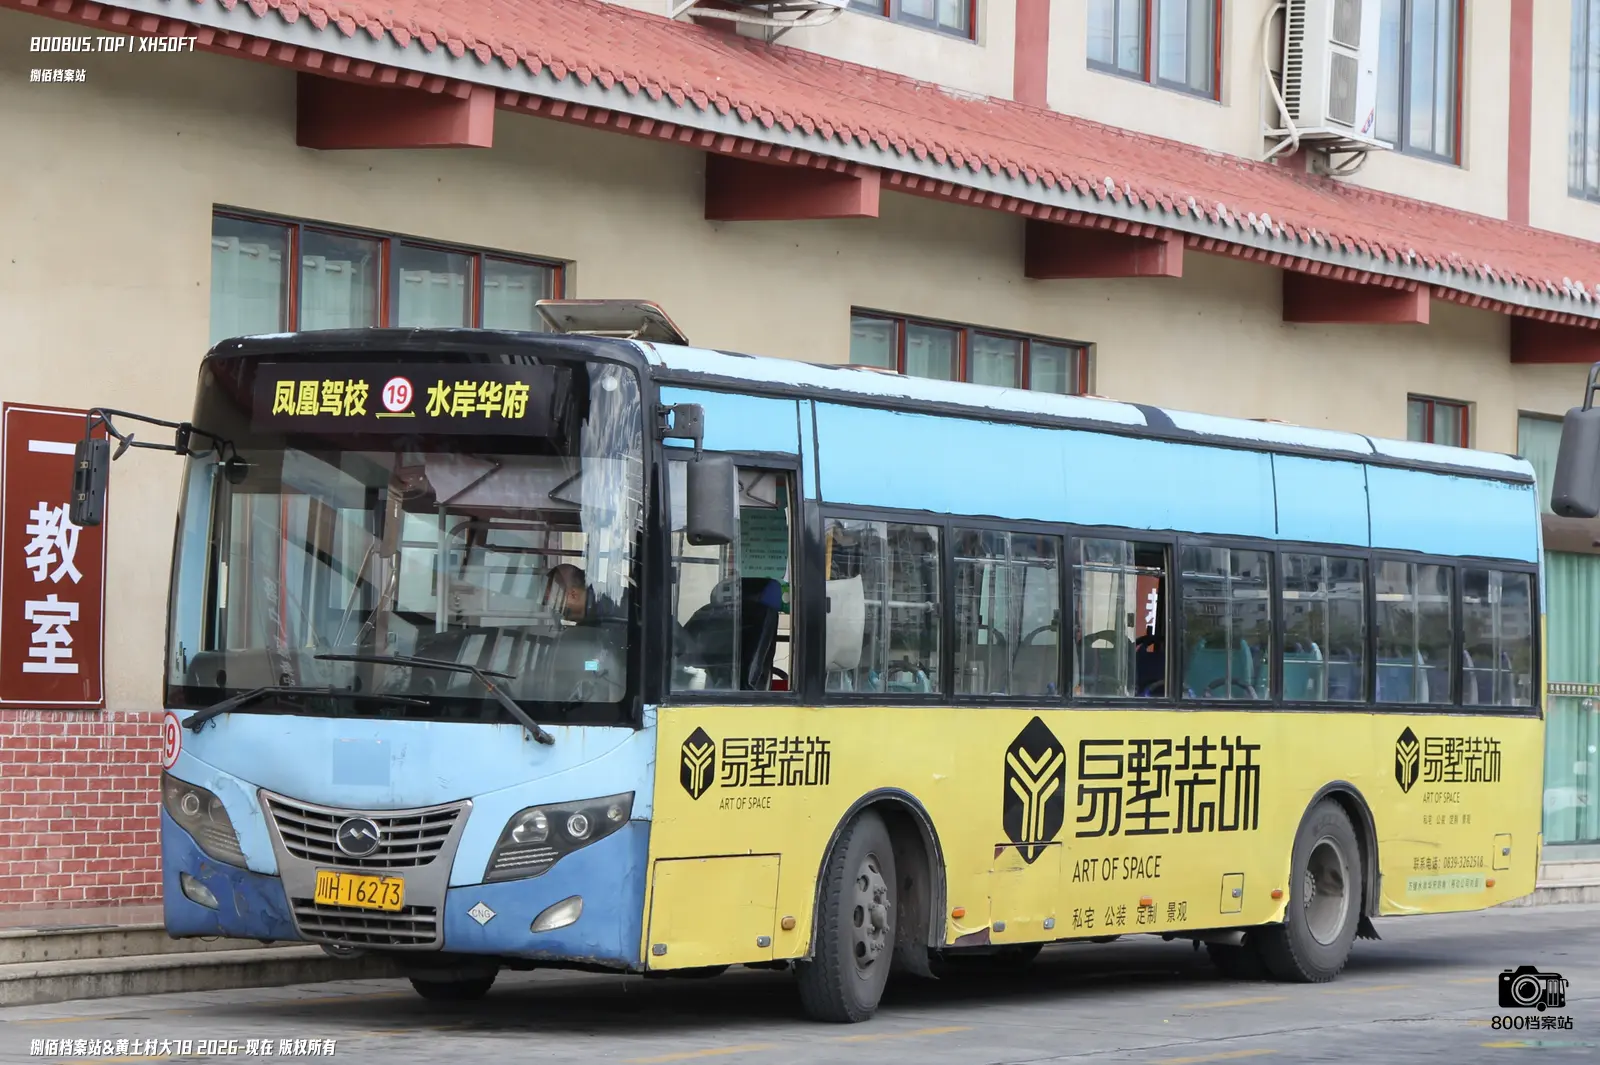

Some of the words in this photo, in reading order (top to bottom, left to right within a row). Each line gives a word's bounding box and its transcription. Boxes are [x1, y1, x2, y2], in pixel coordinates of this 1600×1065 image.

[272, 379, 369, 417] 凤凰驾校
[387, 384, 407, 404] 19
[425, 380, 530, 418] 水岸华府
[23, 440, 84, 674] 一教室
[720, 735, 831, 788] 易墅装饰
[1423, 736, 1501, 783] 易墅装饰
[719, 798, 734, 810] ART
[736, 797, 746, 809] OF
[748, 797, 771, 809] SPACE
[1075, 735, 1261, 838] 易墅装饰
[1423, 791, 1434, 803] ART
[1435, 791, 1442, 803] OF
[1443, 791, 1460, 803] SPACE
[1072, 858, 1098, 882] ART
[1101, 857, 1119, 881] OF
[1123, 855, 1161, 880] SPACE
[472, 909, 490, 918] CNG
[1072, 906, 1094, 930] 私宅
[1104, 904, 1126, 927] 公装
[1136, 902, 1157, 925] 定制
[1166, 900, 1187, 922] 景观
